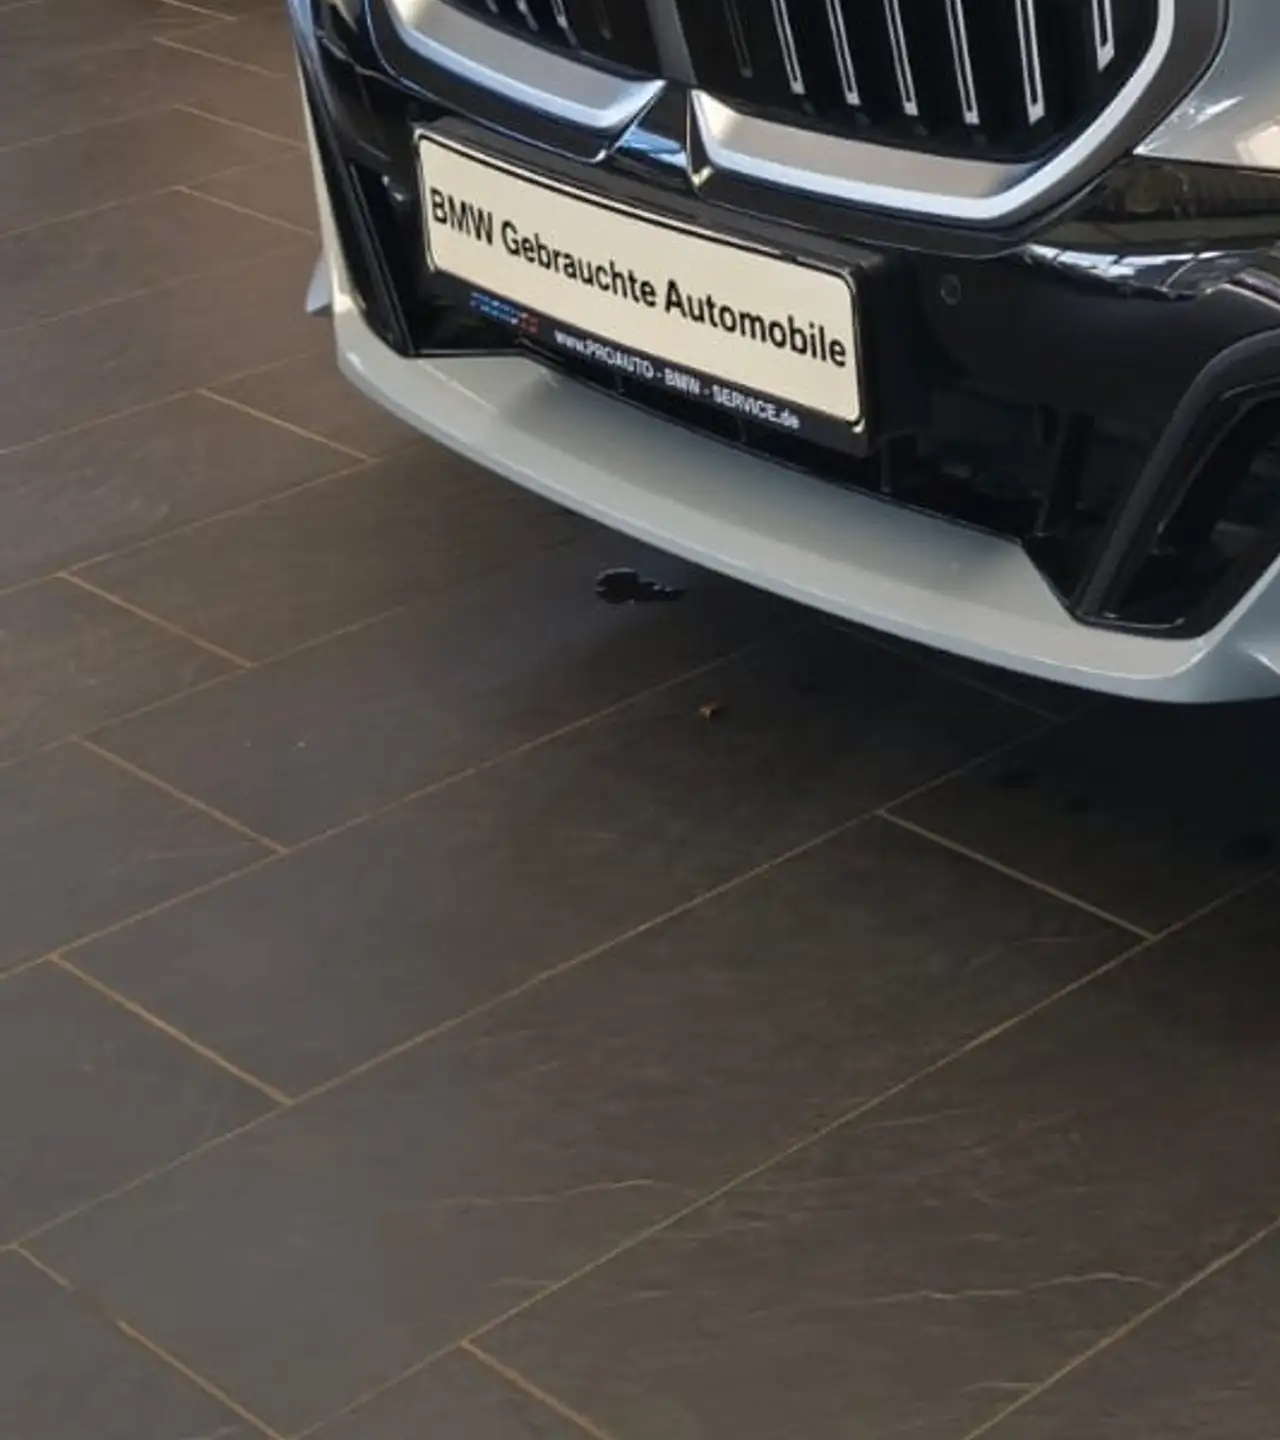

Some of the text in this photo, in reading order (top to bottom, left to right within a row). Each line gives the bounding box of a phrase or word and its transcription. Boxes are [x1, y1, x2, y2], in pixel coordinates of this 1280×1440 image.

[430, 187, 847, 368] BMW Gebrauchte Automobile
[664, 367, 702, 396] BMW
[712, 383, 801, 430] SERVICE.de
